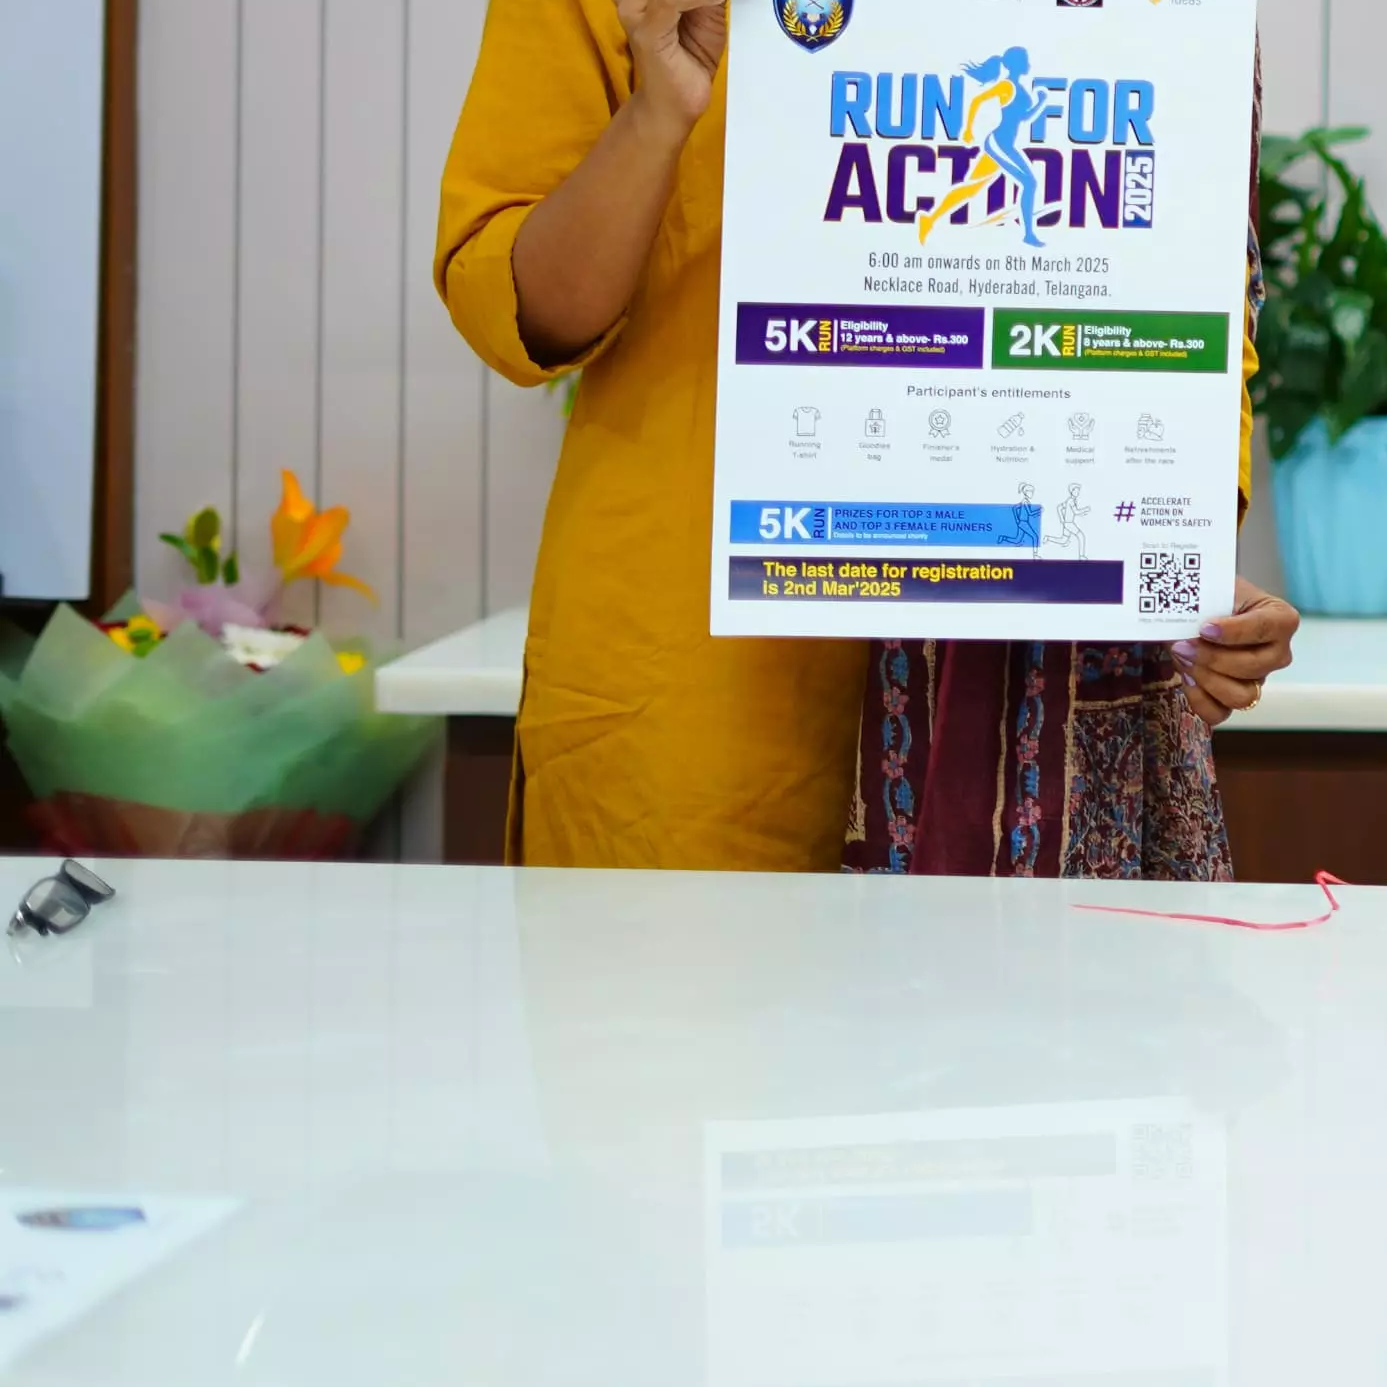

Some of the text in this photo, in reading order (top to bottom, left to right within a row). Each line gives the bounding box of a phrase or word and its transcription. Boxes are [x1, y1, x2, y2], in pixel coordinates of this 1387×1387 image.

[830, 71, 1155, 145] RUN FOR
[1124, 155, 1153, 222] 2025
[869, 252, 1109, 273] 6:00 am onwards on 8th March 2025
[864, 277, 1111, 300] Necklace Road, Hyderabad, Telangana.
[764, 320, 818, 351] 5K
[819, 321, 831, 351] RUN
[841, 321, 888, 332] Eligibility
[1084, 326, 1131, 337] Eligibility
[841, 333, 968, 344] 12 years & above- Rs.300
[1009, 325, 1061, 356] 2K
[1063, 325, 1075, 356] RUN
[1084, 338, 1204, 349] 8 years & above- Rs.300
[907, 385, 1071, 399] Participant's entitlements
[1141, 497, 1191, 506] ACCELERATE
[759, 508, 811, 539] 5K
[814, 509, 825, 538] RUN
[835, 509, 964, 519] PRIZES FOR TOP 3 MALE
[1182, 519, 1212, 527] SAFETY
[834, 521, 992, 532] AND TOP 3 FEMALE RUNNERS
[764, 562, 1013, 582] The last date for registration
[764, 581, 901, 596] is 2nd Mar'2025
